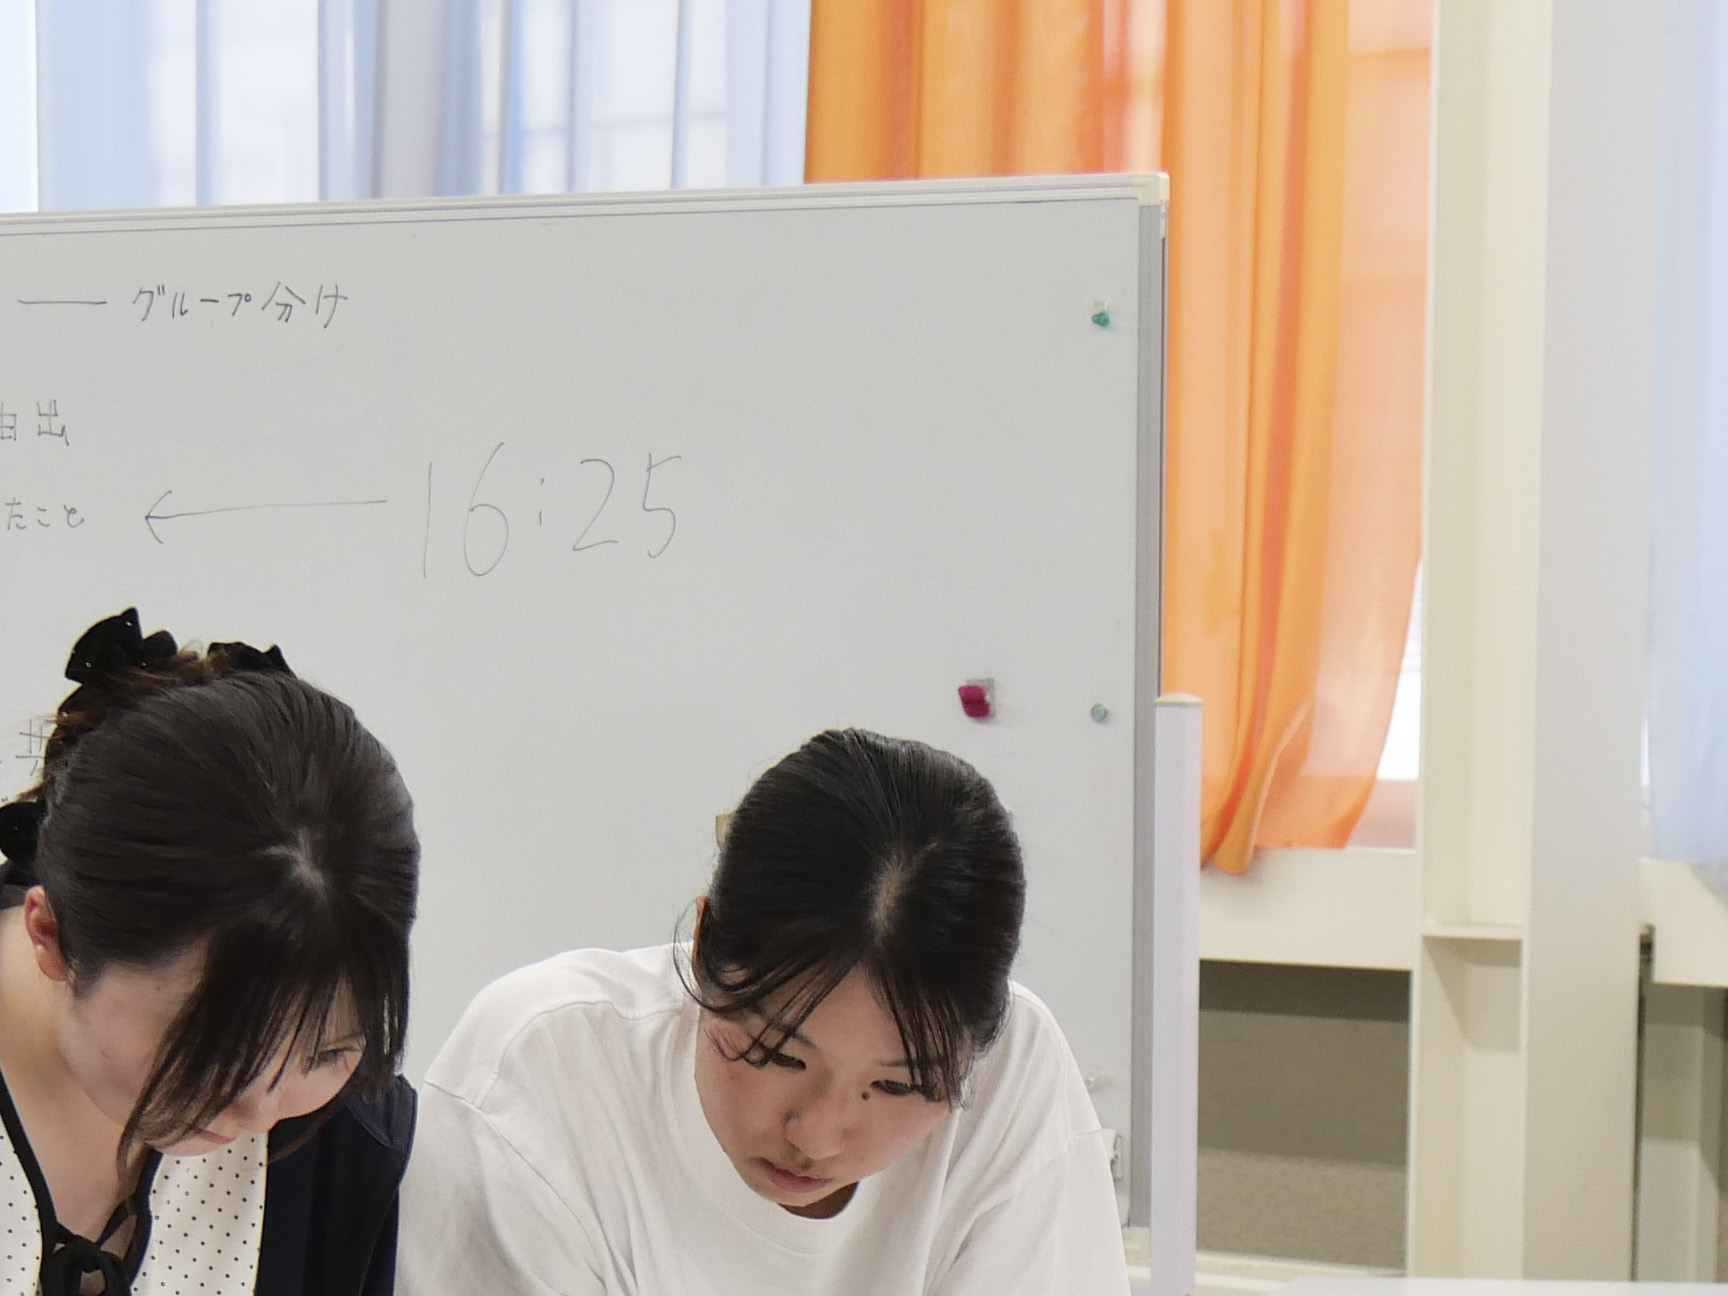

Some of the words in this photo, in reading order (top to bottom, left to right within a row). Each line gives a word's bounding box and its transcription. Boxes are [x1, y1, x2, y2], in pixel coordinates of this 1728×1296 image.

[132, 282, 349, 329] グループ分け
[421, 441, 684, 579] 16:25
